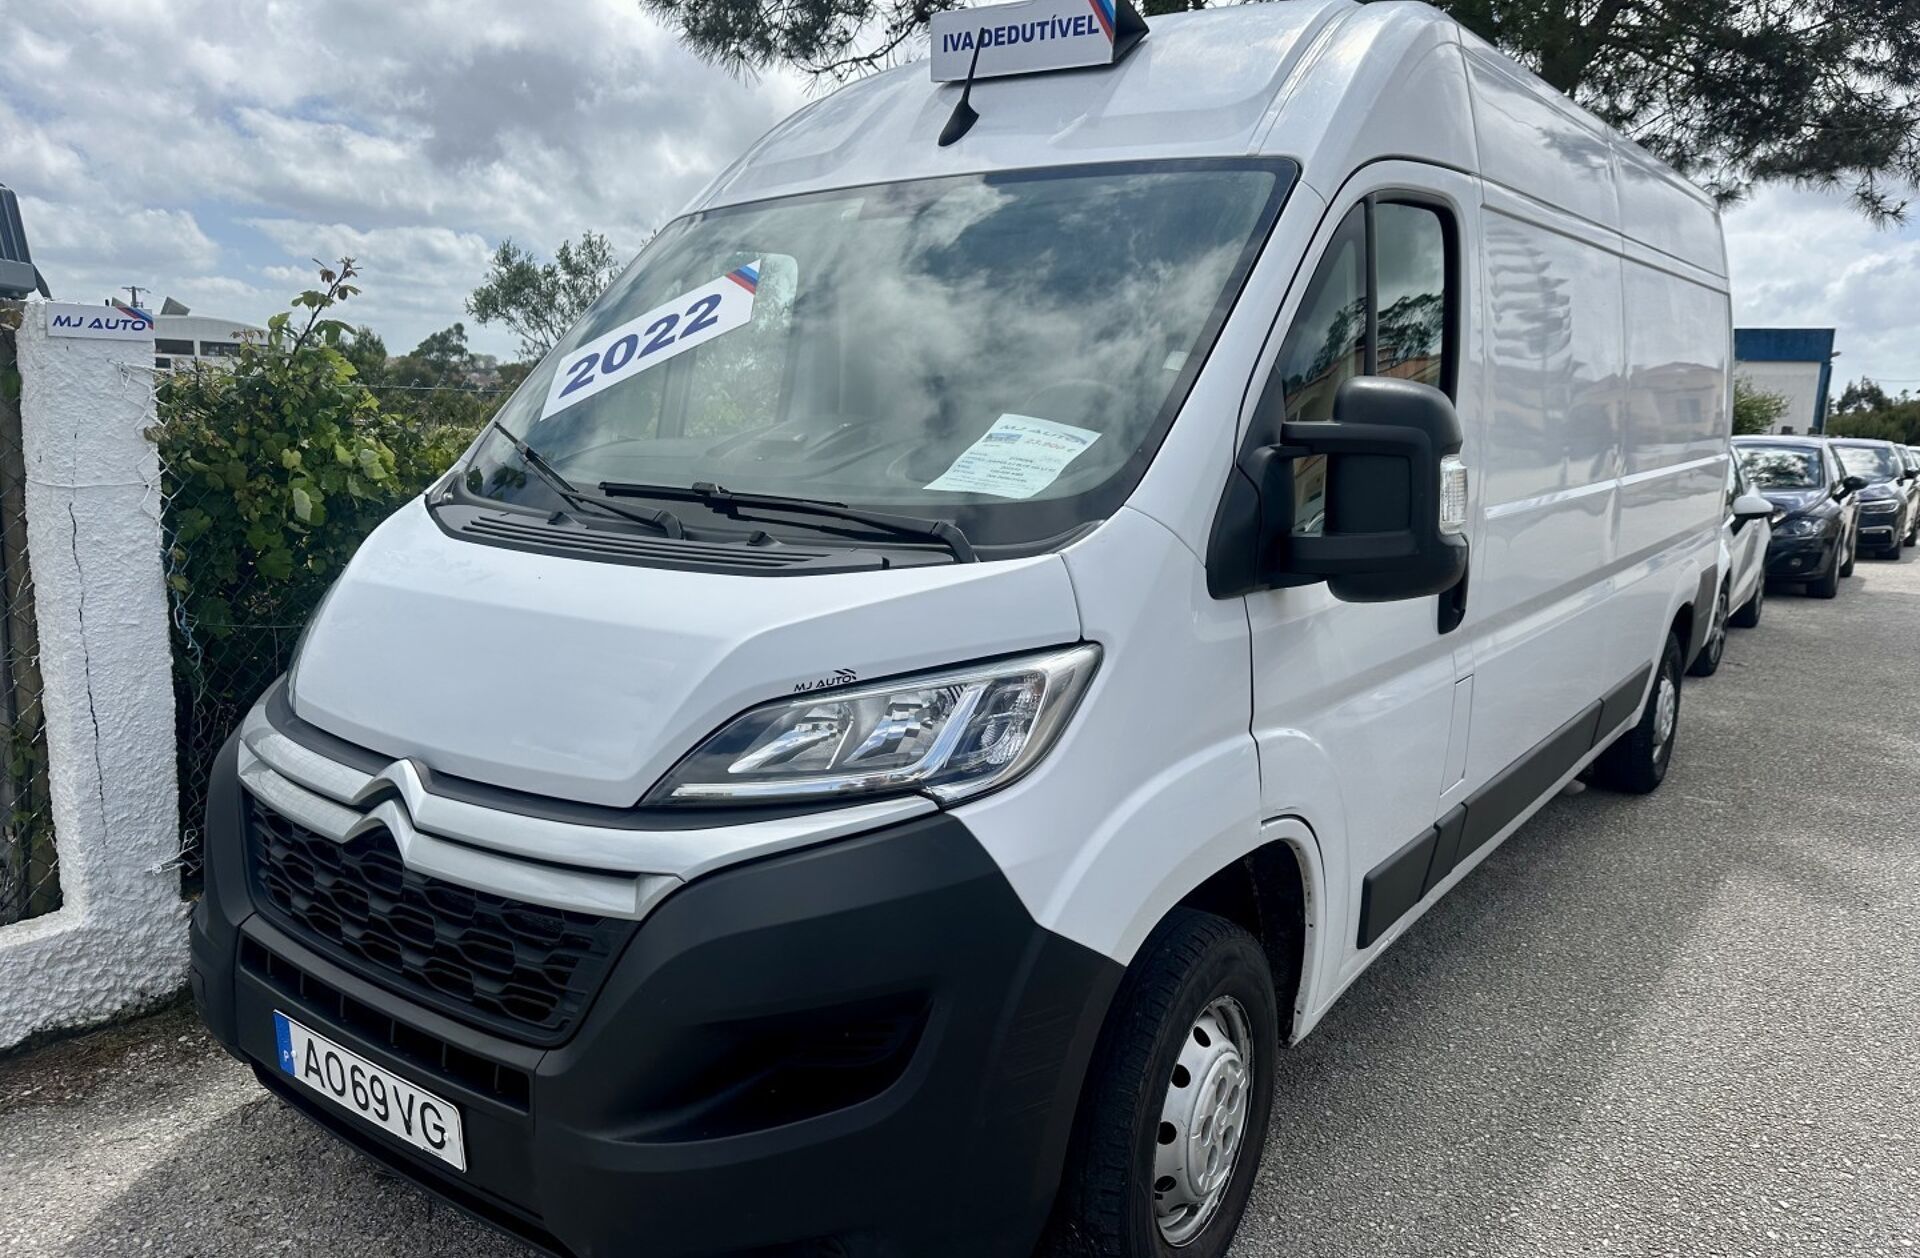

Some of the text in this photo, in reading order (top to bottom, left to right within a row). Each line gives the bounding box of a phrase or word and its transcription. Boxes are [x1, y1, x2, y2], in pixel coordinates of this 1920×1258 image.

[943, 14, 1099, 53] IVA DEDUTÍVEL
[52, 315, 146, 331] MJ AUTO
[559, 293, 722, 399] 2022
[793, 674, 852, 693] MJ AUTO
